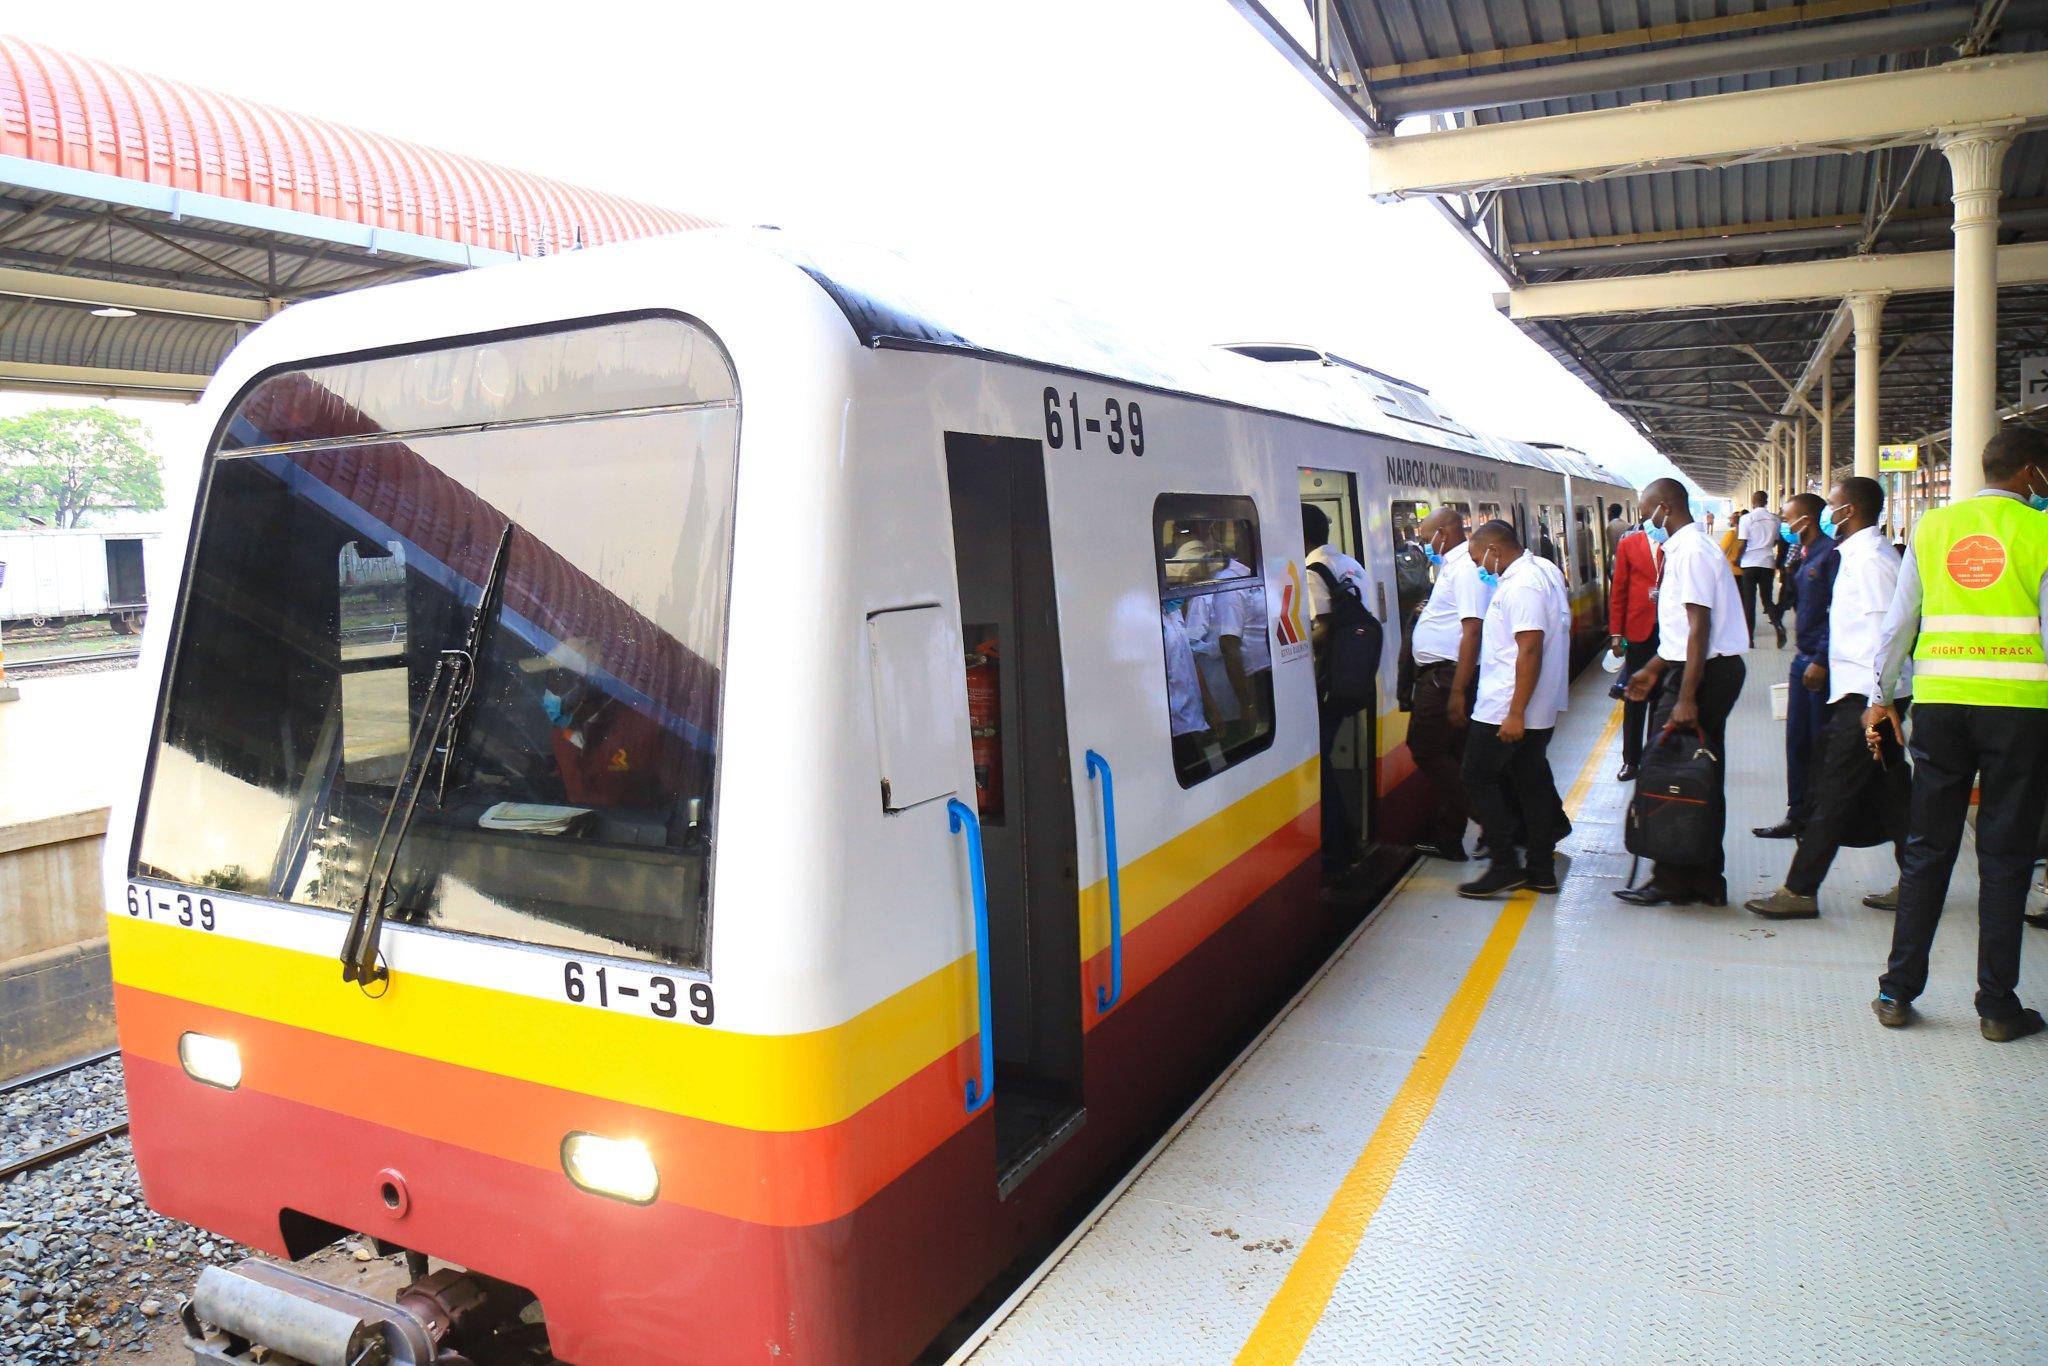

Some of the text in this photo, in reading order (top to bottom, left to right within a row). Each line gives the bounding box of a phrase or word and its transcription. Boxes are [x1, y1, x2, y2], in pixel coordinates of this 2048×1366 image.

[1043, 386, 1145, 457] 61-39
[1386, 455, 1429, 487] NAIROBI
[1429, 462, 1471, 490] COMMUTER
[1931, 646, 2034, 656] RIGHT ON TRACK
[127, 884, 215, 931] 61-39
[564, 961, 715, 1026] 61-39
